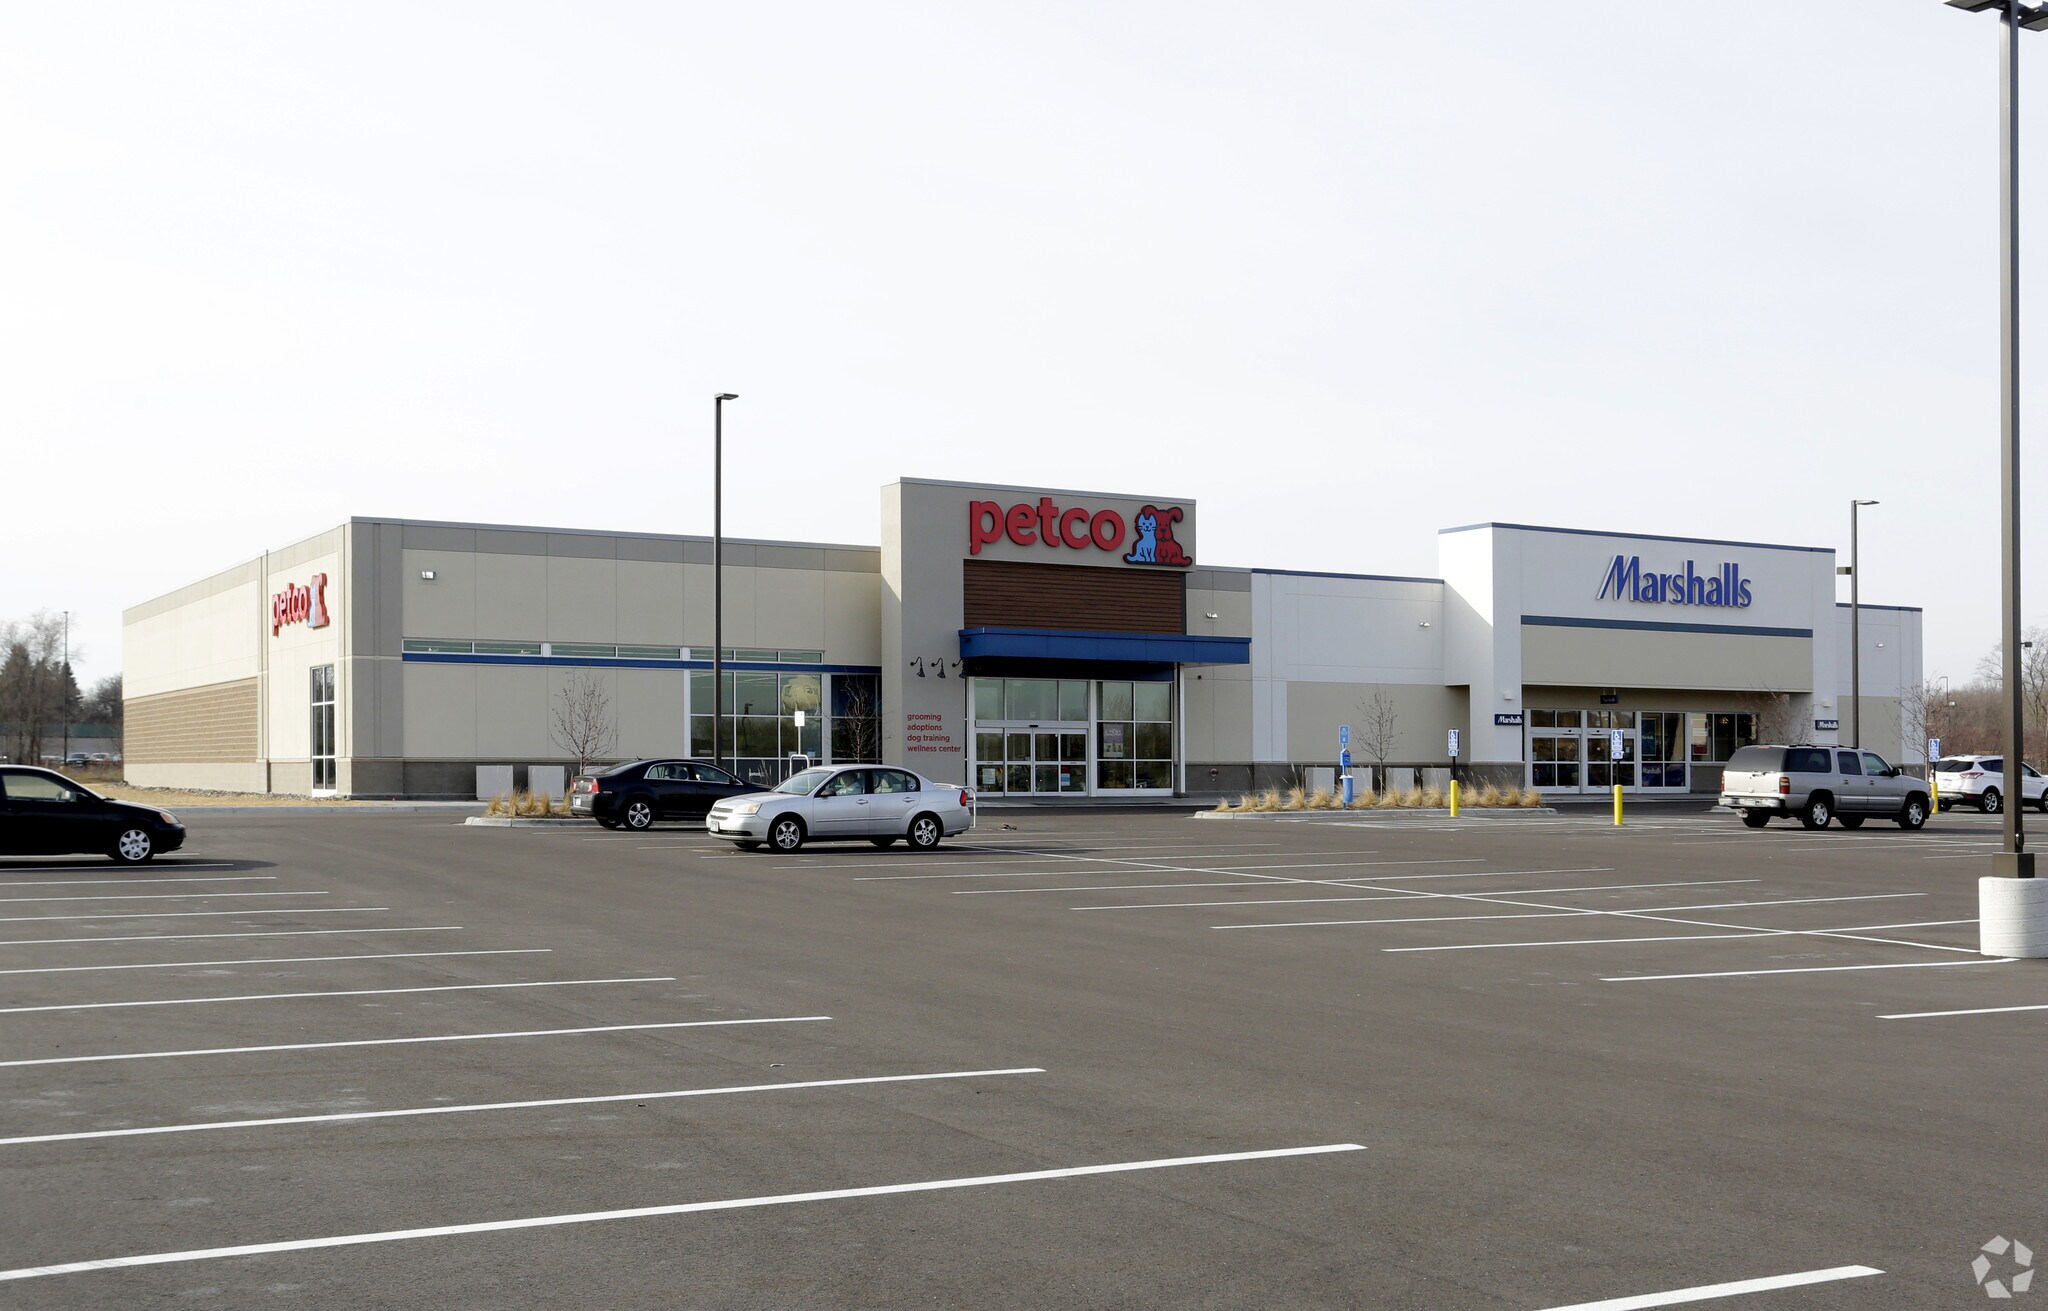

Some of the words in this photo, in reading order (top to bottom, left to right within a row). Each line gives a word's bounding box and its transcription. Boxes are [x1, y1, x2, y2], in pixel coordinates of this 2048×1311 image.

[970, 497, 1126, 555] petco
[1596, 554, 1752, 608] Marshalls
[272, 583, 310, 638] petco
[907, 713, 942, 721] grooming
[907, 724, 943, 732] adoptions
[907, 734, 921, 742] dog
[923, 734, 950, 742] training
